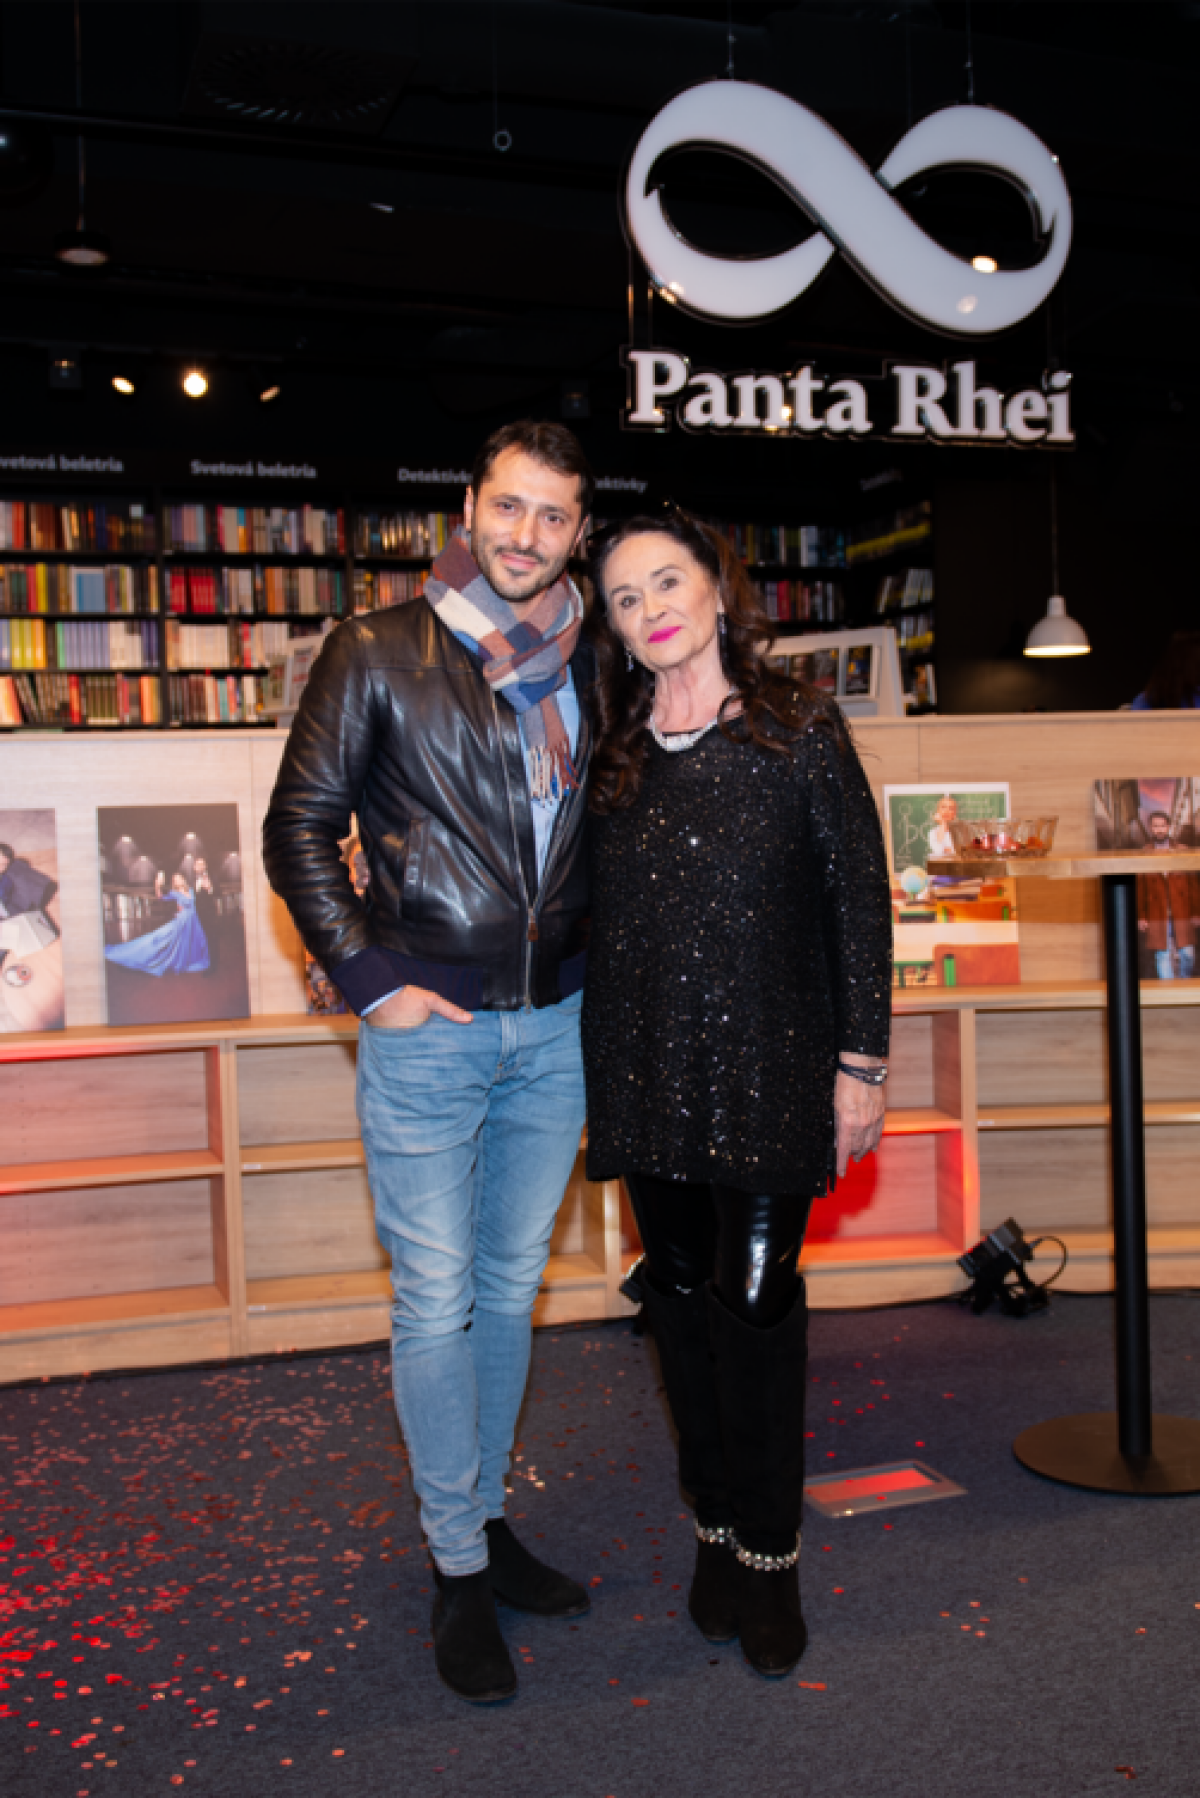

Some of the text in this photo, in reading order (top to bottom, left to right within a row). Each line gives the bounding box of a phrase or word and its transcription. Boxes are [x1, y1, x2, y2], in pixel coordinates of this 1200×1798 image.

[627, 351, 1074, 442] Panta Rhei
[0, 454, 123, 472] vetová beletria
[190, 458, 318, 478] Svetová beletria
[592, 475, 649, 494] ektívky
